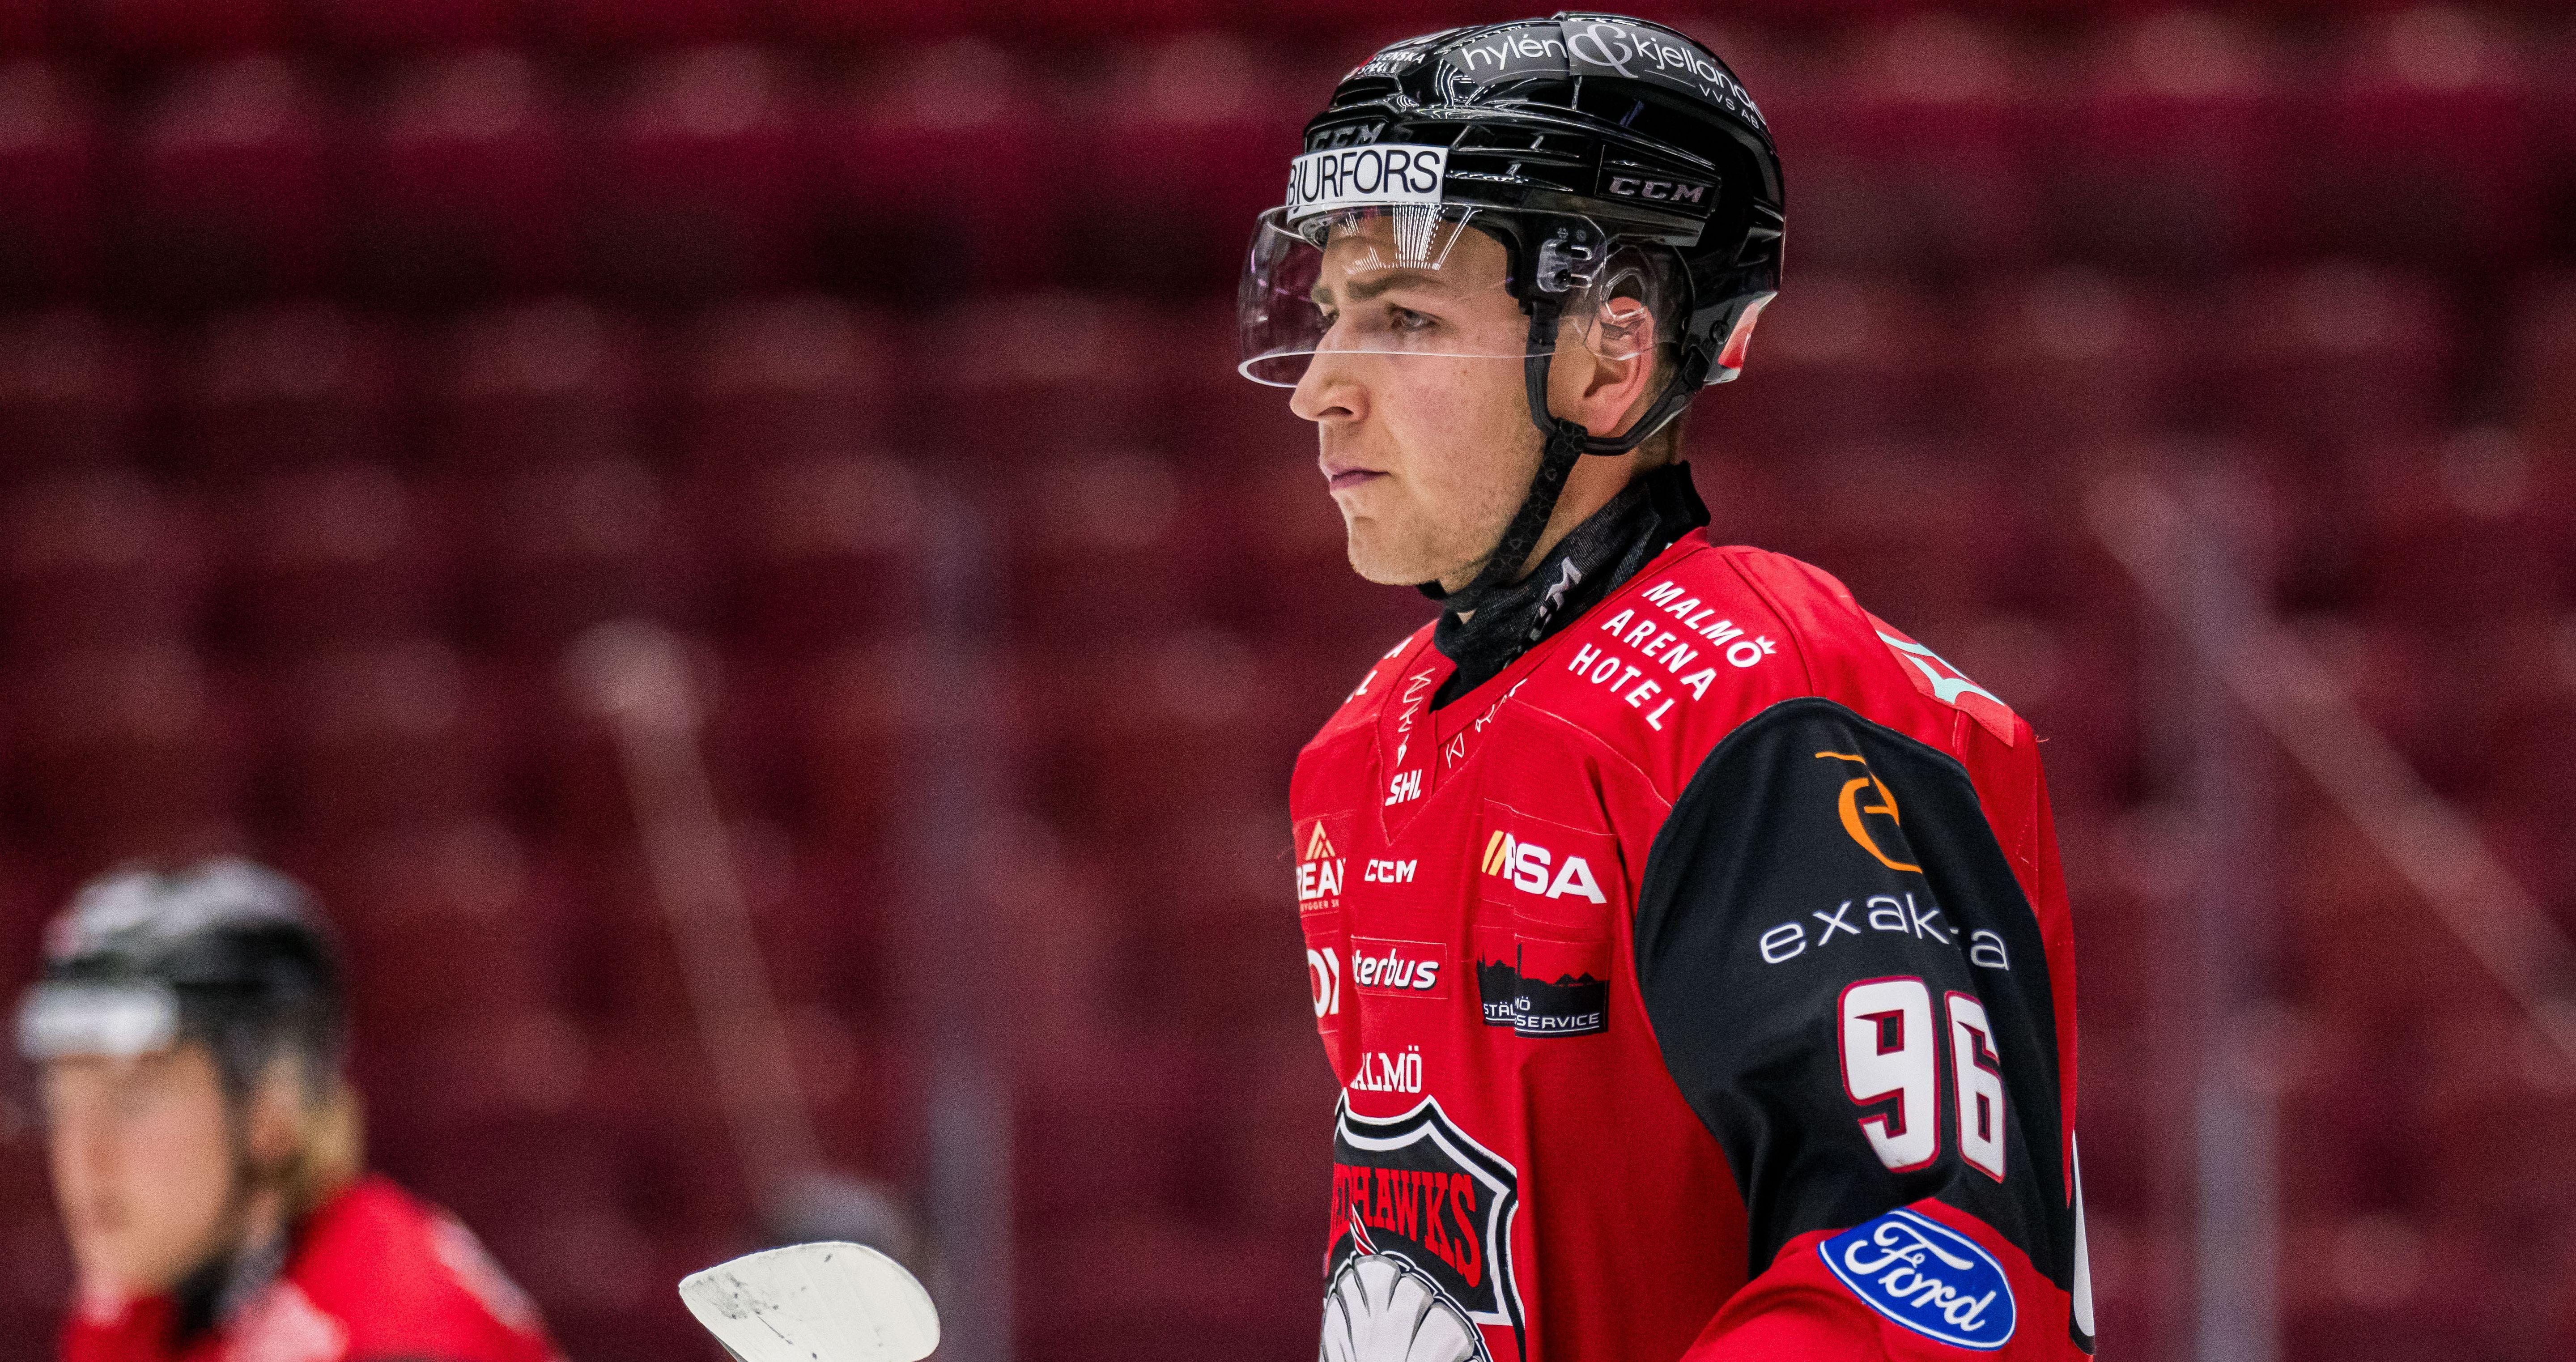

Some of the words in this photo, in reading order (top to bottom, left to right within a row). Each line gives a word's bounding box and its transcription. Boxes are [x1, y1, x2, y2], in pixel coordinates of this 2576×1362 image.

[1461, 34, 1568, 71] hylén
[1568, 24, 1638, 78] &
[1699, 84, 1735, 110] VVS
[1741, 109, 1759, 129] AB
[1609, 177, 1704, 203] CCM
[1601, 608, 1718, 702] ARENA
[1568, 643, 1677, 731] HOTEL
[1385, 769, 1423, 806] SHL
[1365, 860, 1417, 883] CCM
[1760, 894, 2010, 971] exaka
[1352, 948, 1440, 991] terbus
[1837, 975, 2006, 1185] 96
[1844, 1220, 1998, 1333] Ford
